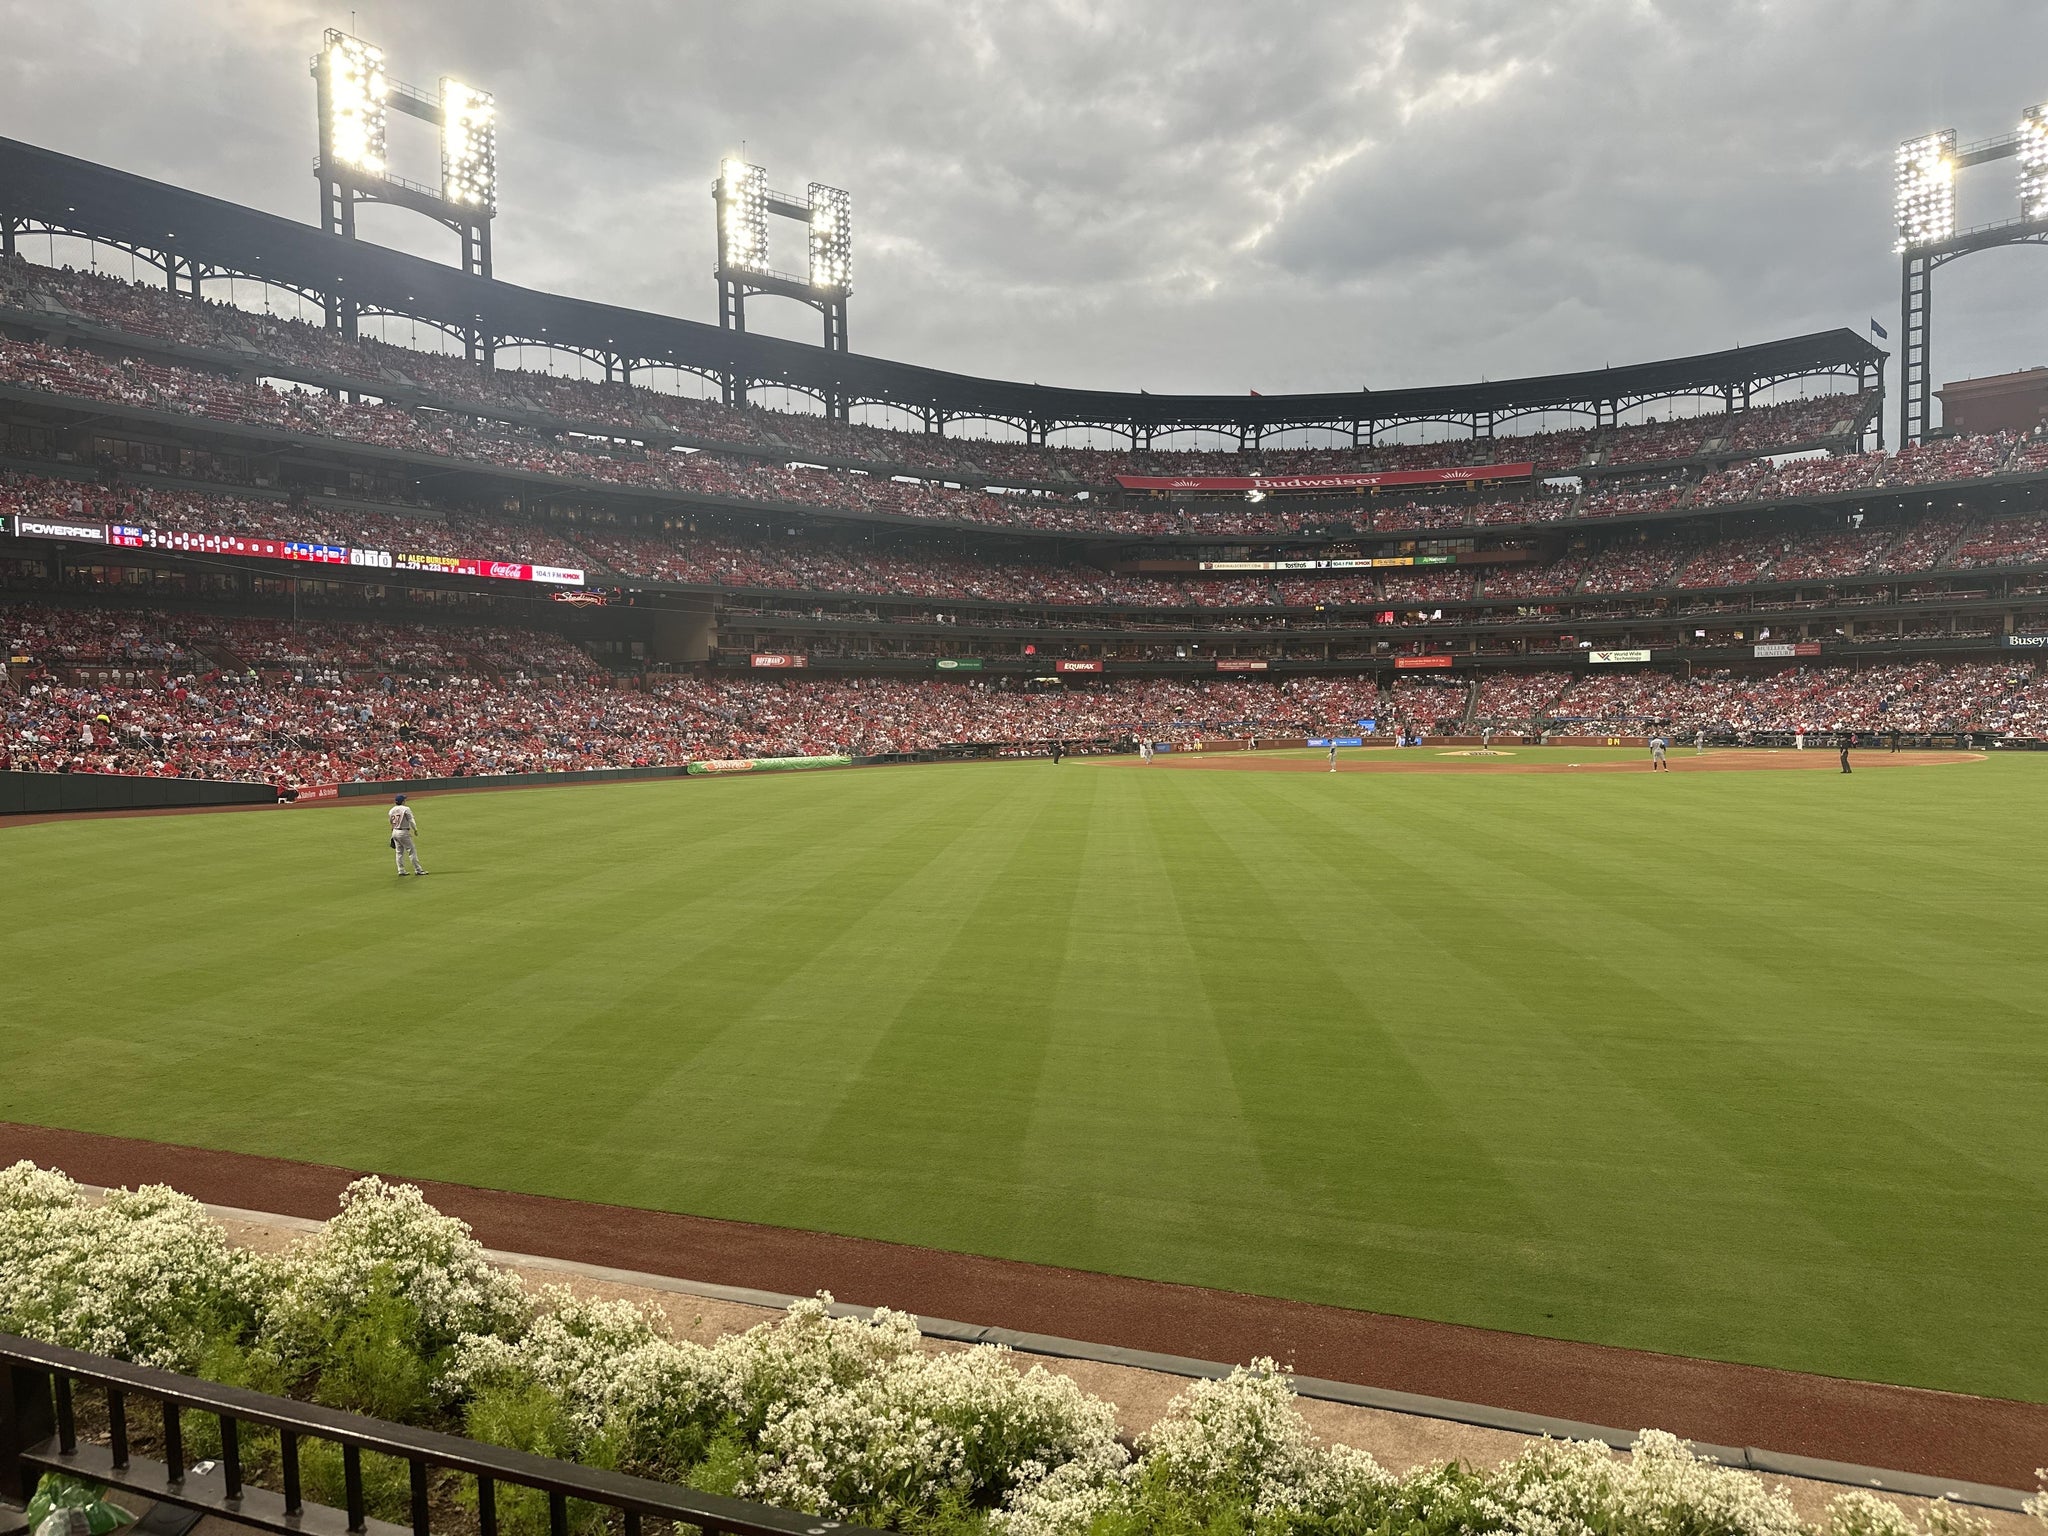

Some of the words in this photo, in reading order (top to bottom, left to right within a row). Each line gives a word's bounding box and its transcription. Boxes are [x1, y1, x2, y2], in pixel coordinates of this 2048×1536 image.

[1254, 478, 1381, 488] Budweiser
[124, 527, 139, 536] CHC
[150, 529, 156, 538] 3
[168, 531, 172, 540] 1
[293, 543, 298, 551] 4
[124, 537, 138, 545] STL
[150, 539, 156, 547] 3
[200, 544, 204, 552] 1
[216, 545, 220, 553] 1
[355, 554, 360, 563] 0
[383, 557, 388, 566] 0
[408, 554, 425, 563] ALEC
[426, 556, 459, 565] BURLESON
[1064, 663, 1095, 671] EQUIFAX
[714, 760, 746, 769] SERVPRO
[392, 815, 401, 827] 27
